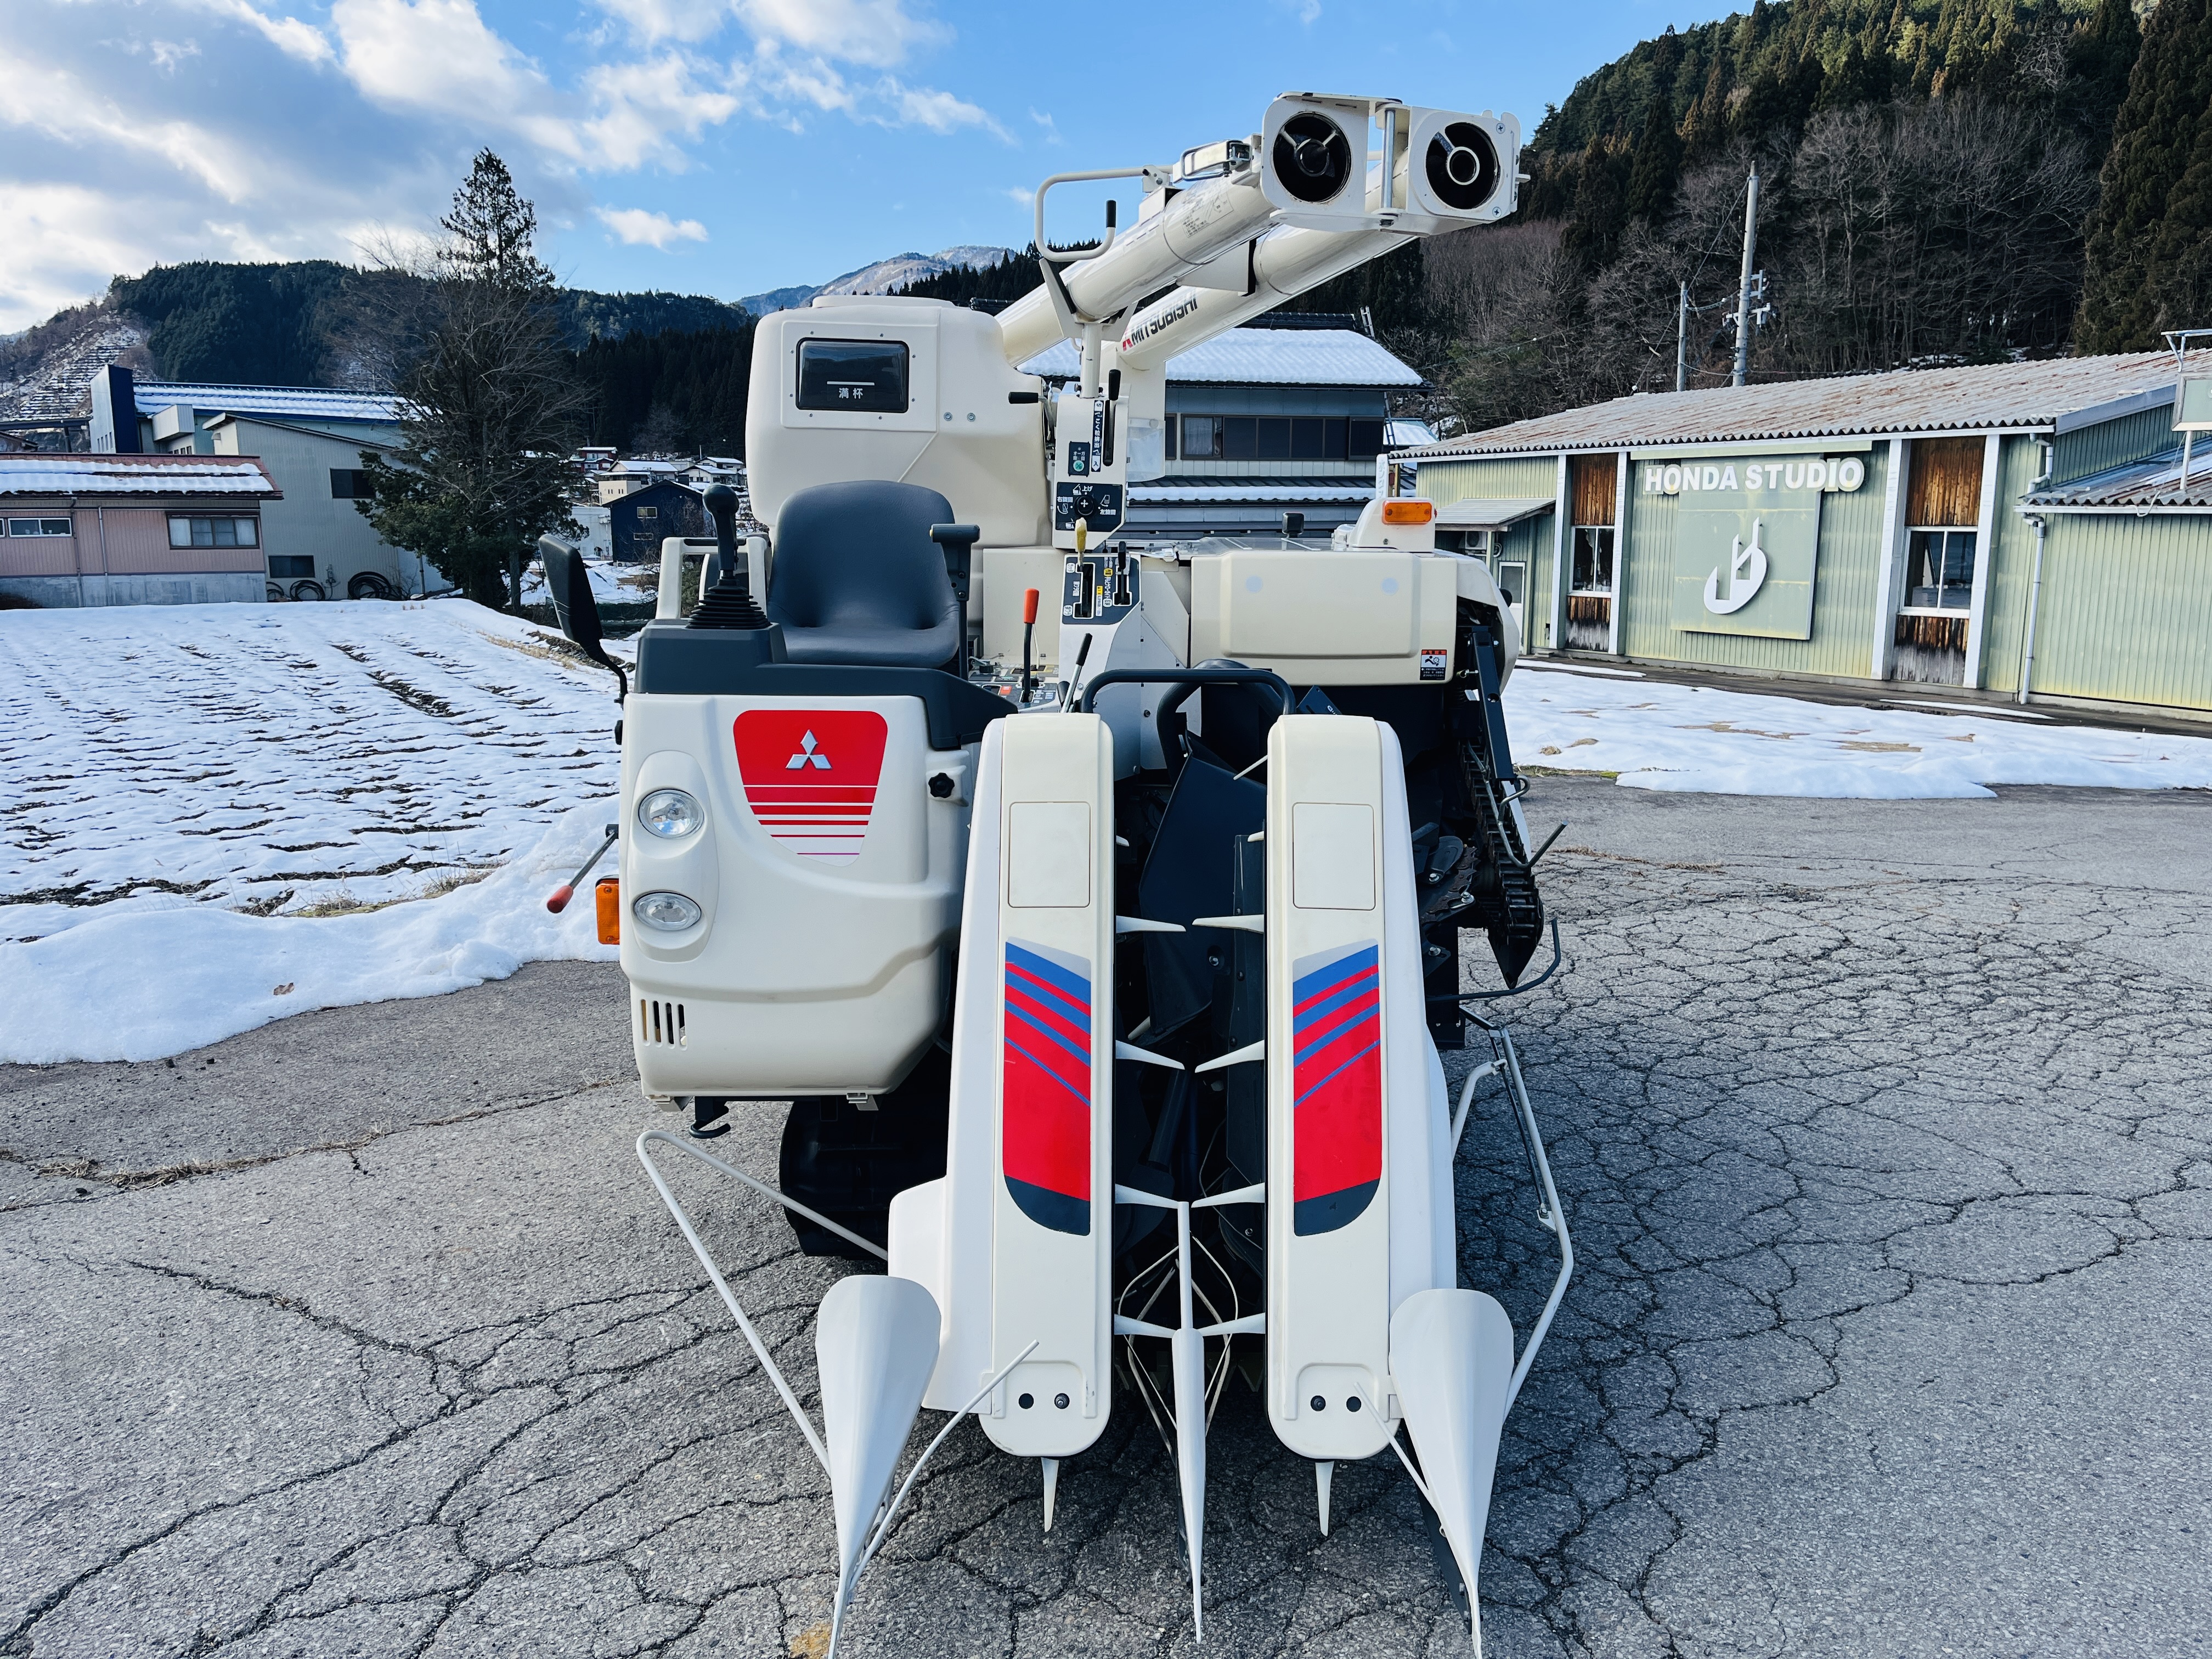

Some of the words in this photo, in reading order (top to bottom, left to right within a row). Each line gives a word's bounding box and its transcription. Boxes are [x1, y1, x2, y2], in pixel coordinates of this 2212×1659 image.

[1131, 294, 1198, 345] MITSUBISHI
[838, 387, 863, 399] 満杯
[1644, 465, 1739, 492] HONDA
[1745, 459, 1864, 491] STUDIO
